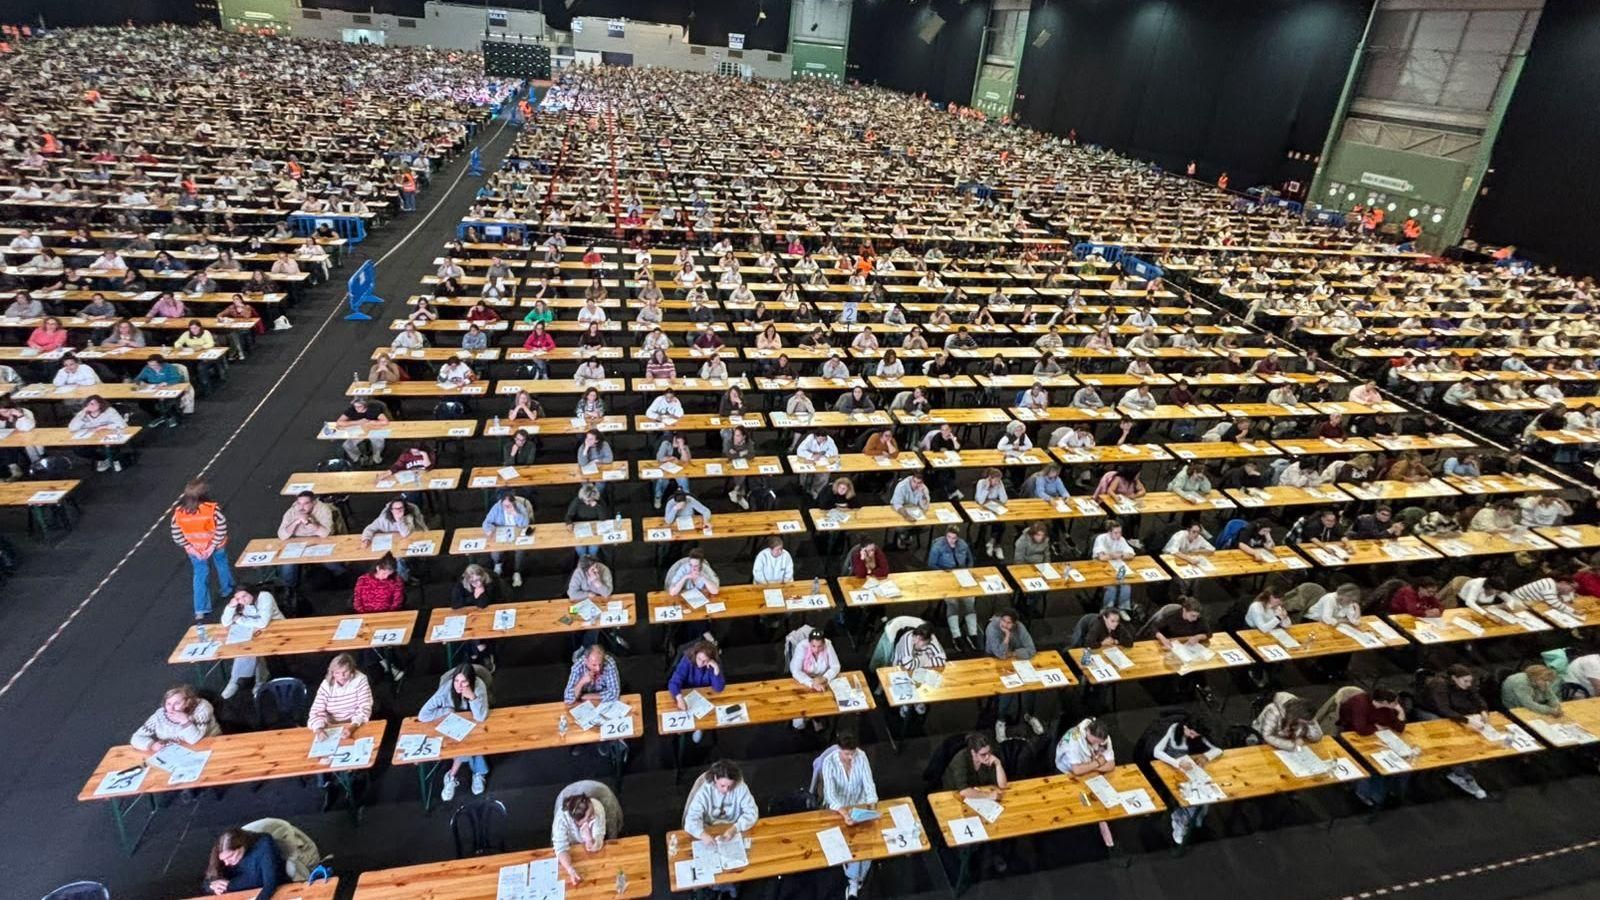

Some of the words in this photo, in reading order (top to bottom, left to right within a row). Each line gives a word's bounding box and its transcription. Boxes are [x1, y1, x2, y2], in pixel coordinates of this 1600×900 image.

[846, 307, 854, 320] 2
[607, 533, 623, 541] 62
[464, 541, 479, 549] 61
[248, 554, 268, 563] 59
[1030, 581, 1043, 589] 49
[808, 597, 824, 606] 46
[856, 593, 870, 602] 47
[605, 614, 623, 623] 44
[660, 609, 677, 618] 45
[379, 631, 397, 642] 42
[187, 646, 208, 657] 41
[1045, 673, 1061, 683] 30
[1097, 668, 1113, 679] 31
[669, 717, 686, 728] 27
[606, 723, 625, 735] 26
[1337, 765, 1348, 776] 9
[963, 824, 975, 838] 4
[898, 835, 908, 848] 3
